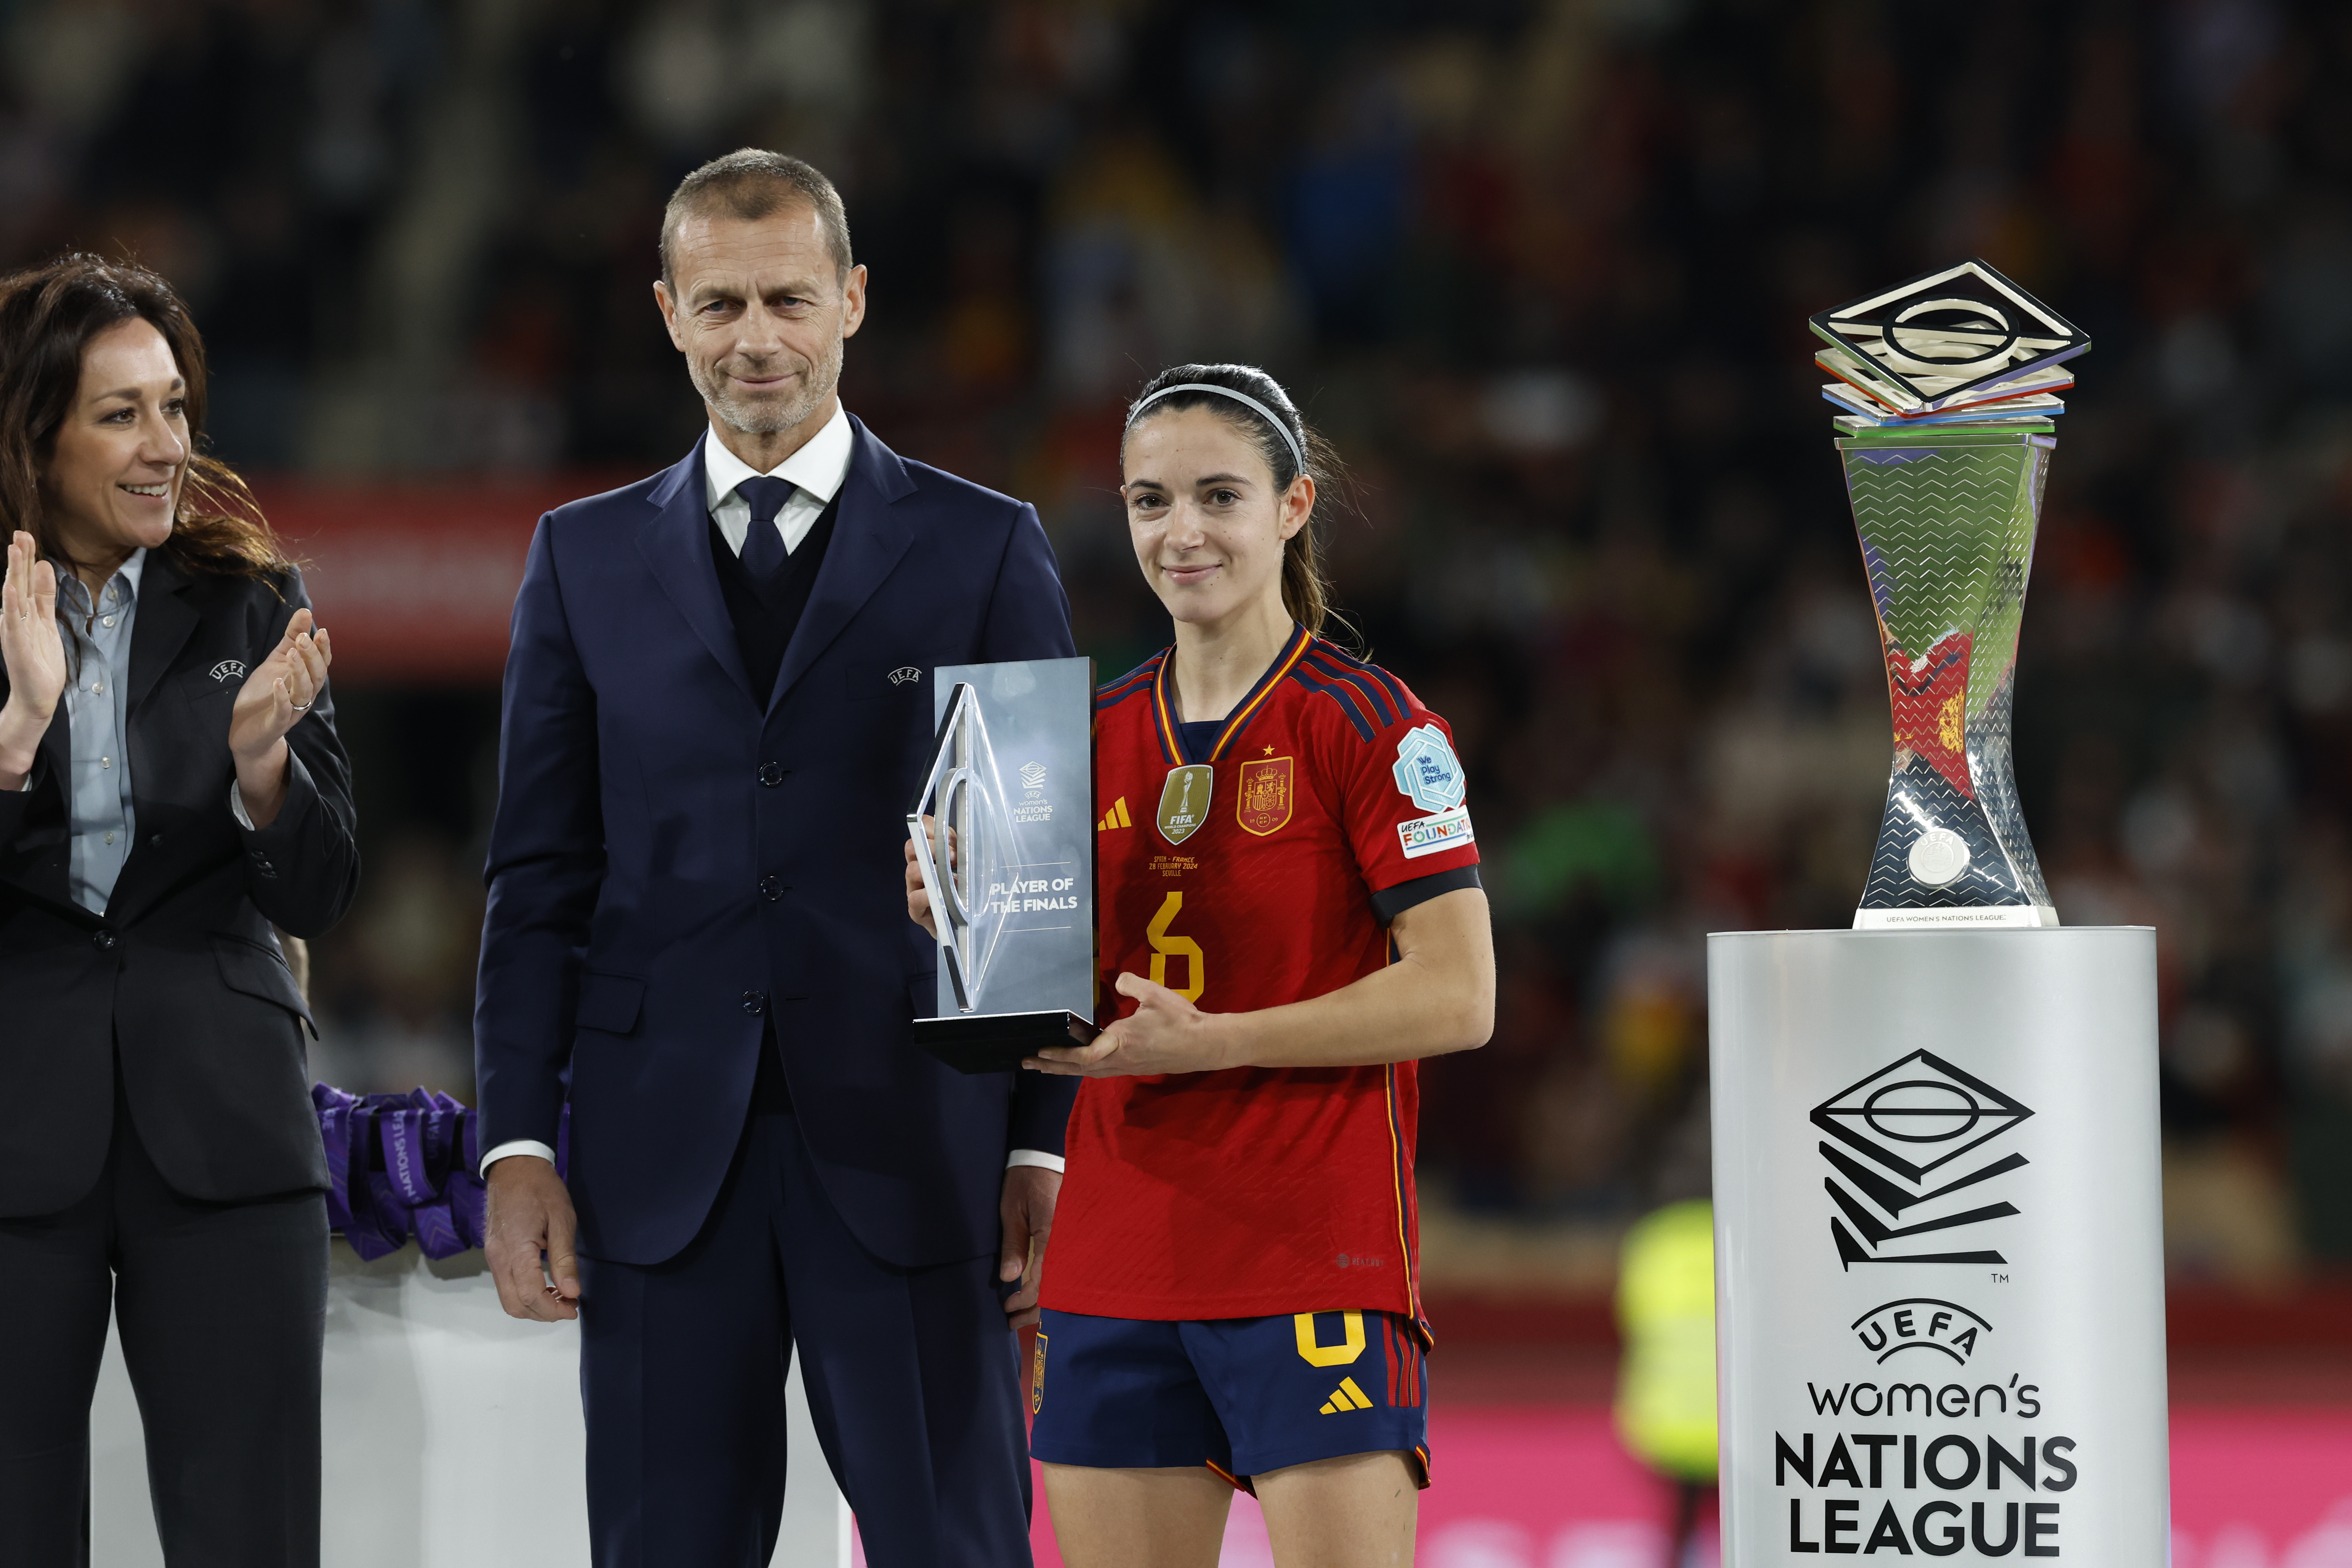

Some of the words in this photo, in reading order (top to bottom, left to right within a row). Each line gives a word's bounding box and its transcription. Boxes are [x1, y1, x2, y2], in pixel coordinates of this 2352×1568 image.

[212, 662, 243, 679] UEFA
[890, 669, 919, 684] UEFA
[1417, 755, 1432, 764] We
[1421, 765, 1440, 775] Play
[1425, 772, 1451, 784] Strong
[1013, 805, 1053, 815] NATIONS
[1016, 813, 1051, 823] LEAGUE
[1401, 821, 1426, 833] UEFA
[1921, 833, 1954, 846] UEFA
[991, 880, 1049, 895] PLAYER
[1051, 878, 1074, 891] OF
[991, 900, 1020, 914] THE
[1024, 896, 1078, 912] FINALS
[1146, 891, 1204, 1004] 6
[394, 1138, 416, 1198] NATIONS
[1858, 1309, 1978, 1357] UEFA
[1807, 1373, 2041, 1419] women's
[1775, 1430, 2078, 1492] NATIONS
[1790, 1498, 2060, 1557] LEAGUE
